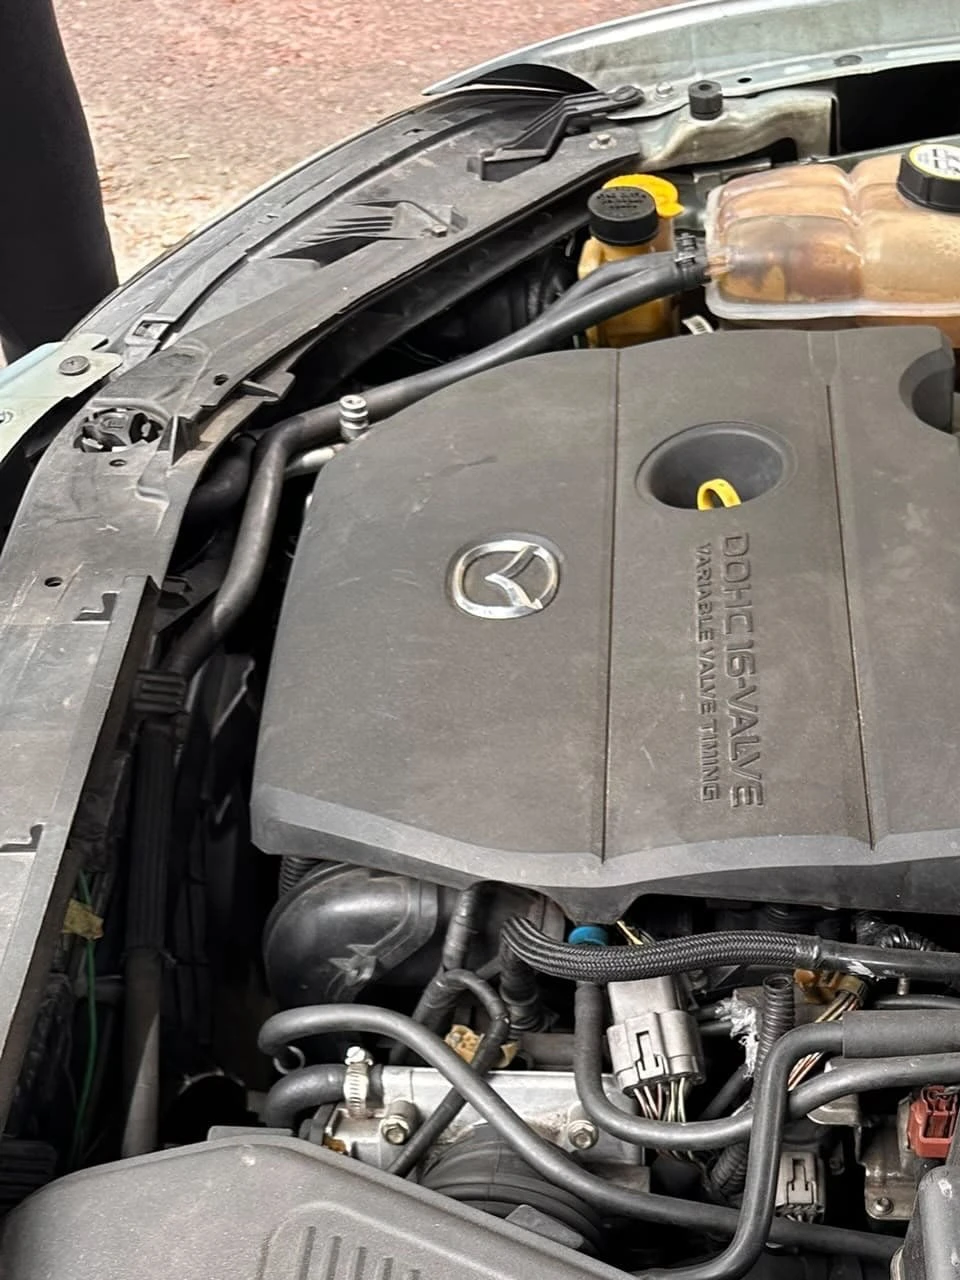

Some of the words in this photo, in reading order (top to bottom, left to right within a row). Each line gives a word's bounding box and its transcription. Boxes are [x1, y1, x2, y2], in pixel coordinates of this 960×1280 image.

[696, 542, 714, 643] VARIABLE
[721, 533, 754, 635] DOHC
[698, 647, 717, 714] VALVE
[725, 640, 763, 807] 16-VALVE
[699, 718, 721, 801] TIMING
